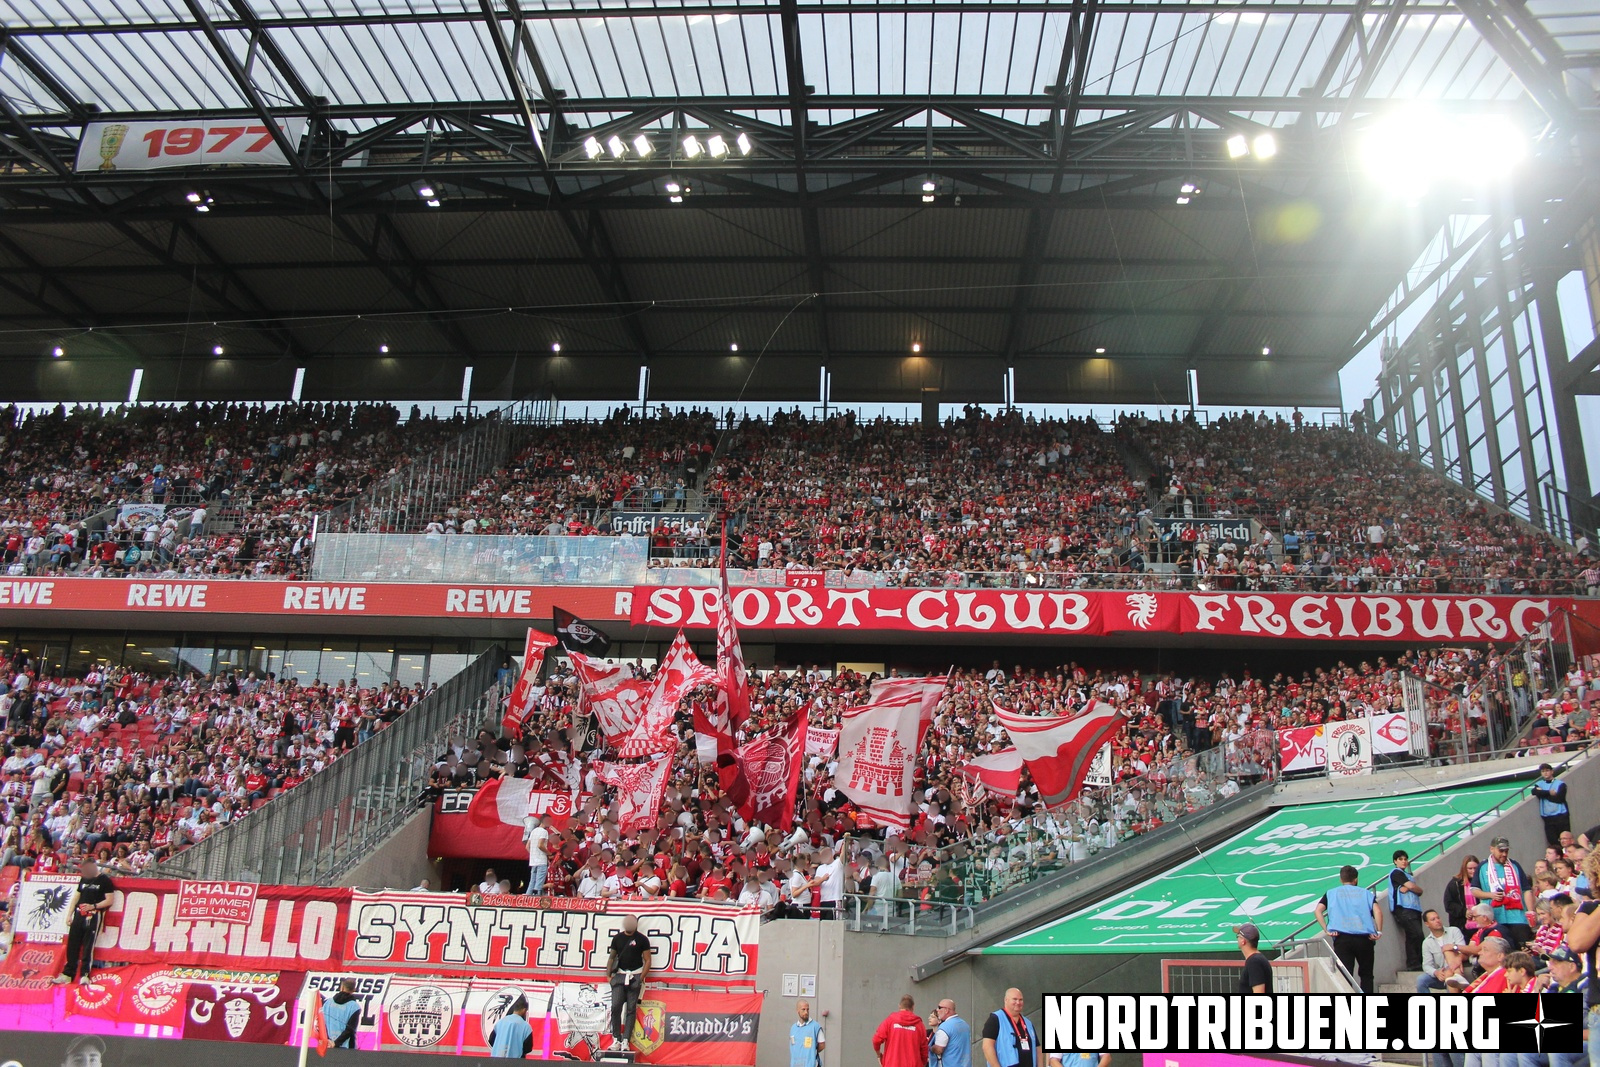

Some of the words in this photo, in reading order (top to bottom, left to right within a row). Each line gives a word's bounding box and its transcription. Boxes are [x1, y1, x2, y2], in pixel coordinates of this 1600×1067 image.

[142, 126, 284, 158] 1977
[613, 516, 655, 534] Gaffel
[1200, 521, 1249, 542] ölsch
[0, 582, 54, 605] EWE
[127, 584, 207, 607] REWE
[283, 586, 366, 611] REWE
[445, 589, 532, 613] REWE
[1190, 593, 1555, 642] FREIBURG
[1331, 723, 1366, 739] FREIBURGER
[1254, 810, 1506, 841] Bestens
[30, 874, 82, 883] HERWELZER
[184, 884, 253, 897] KHALID
[182, 896, 207, 905] FÜR
[210, 897, 251, 909] IMMER
[515, 895, 541, 908] CLUB
[551, 898, 595, 911] FREIBURG
[190, 907, 209, 915] BEI
[212, 908, 239, 917] UNS
[26, 932, 64, 943] BUEBE
[354, 903, 749, 975] SYNTHESIA
[308, 976, 385, 994] SCHISS
[151, 998, 178, 1016] RECHTS
[399, 1017, 442, 1025] SYNTHESIA
[669, 1014, 753, 1038] Knaddly's
